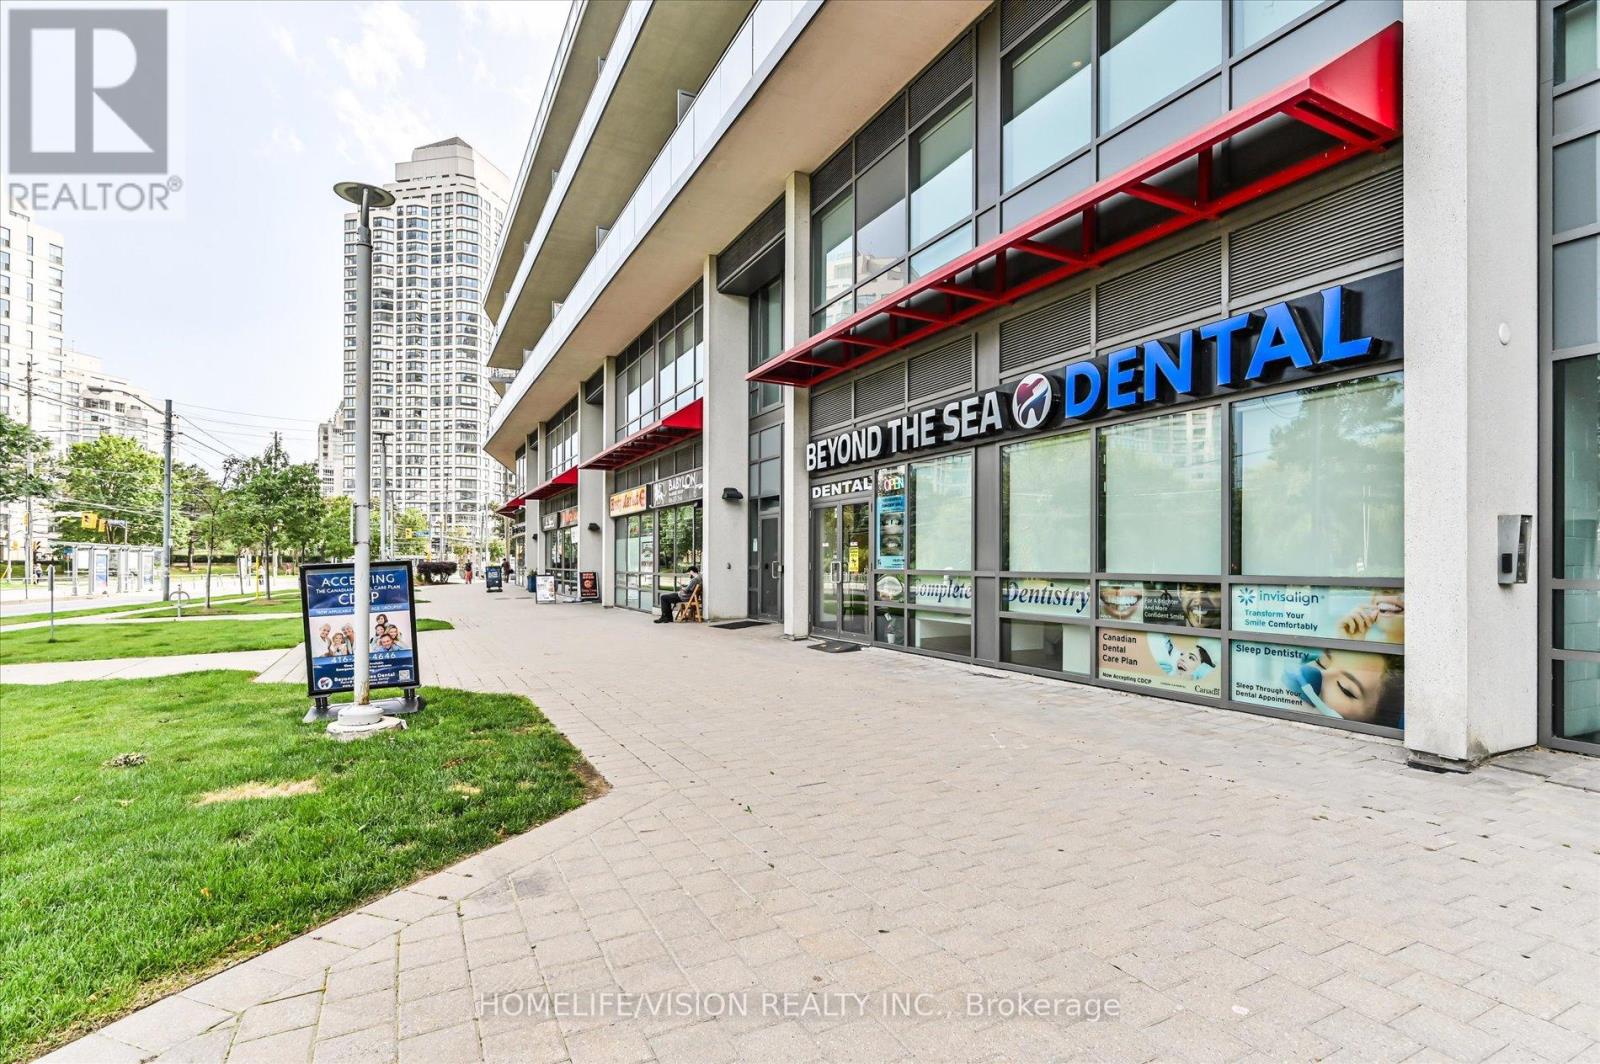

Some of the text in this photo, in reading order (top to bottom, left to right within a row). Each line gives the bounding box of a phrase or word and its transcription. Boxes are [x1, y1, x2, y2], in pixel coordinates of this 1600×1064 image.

[806, 285, 1376, 472] BEYOND THE SEA DENTAL
[811, 475, 873, 499] DENTAL
[883, 476, 905, 491] OPEN
[321, 573, 396, 587] ACCEING
[1006, 581, 1090, 613] Dentistry
[1259, 590, 1320, 606] invisalign
[1245, 609, 1305, 619] Transform Your
[1245, 619, 1318, 632] Smile Comfortably
[1102, 633, 1137, 644] Canadian
[1102, 644, 1126, 653] Dental
[1235, 644, 1310, 660] Sleep Dentistry
[1102, 654, 1138, 666] Care Plan
[1113, 673, 1136, 683] Accepting
[1137, 677, 1152, 685] CDCP
[1235, 682, 1302, 697] Sleep Through Your
[1235, 690, 1303, 706] Dental Appointment
